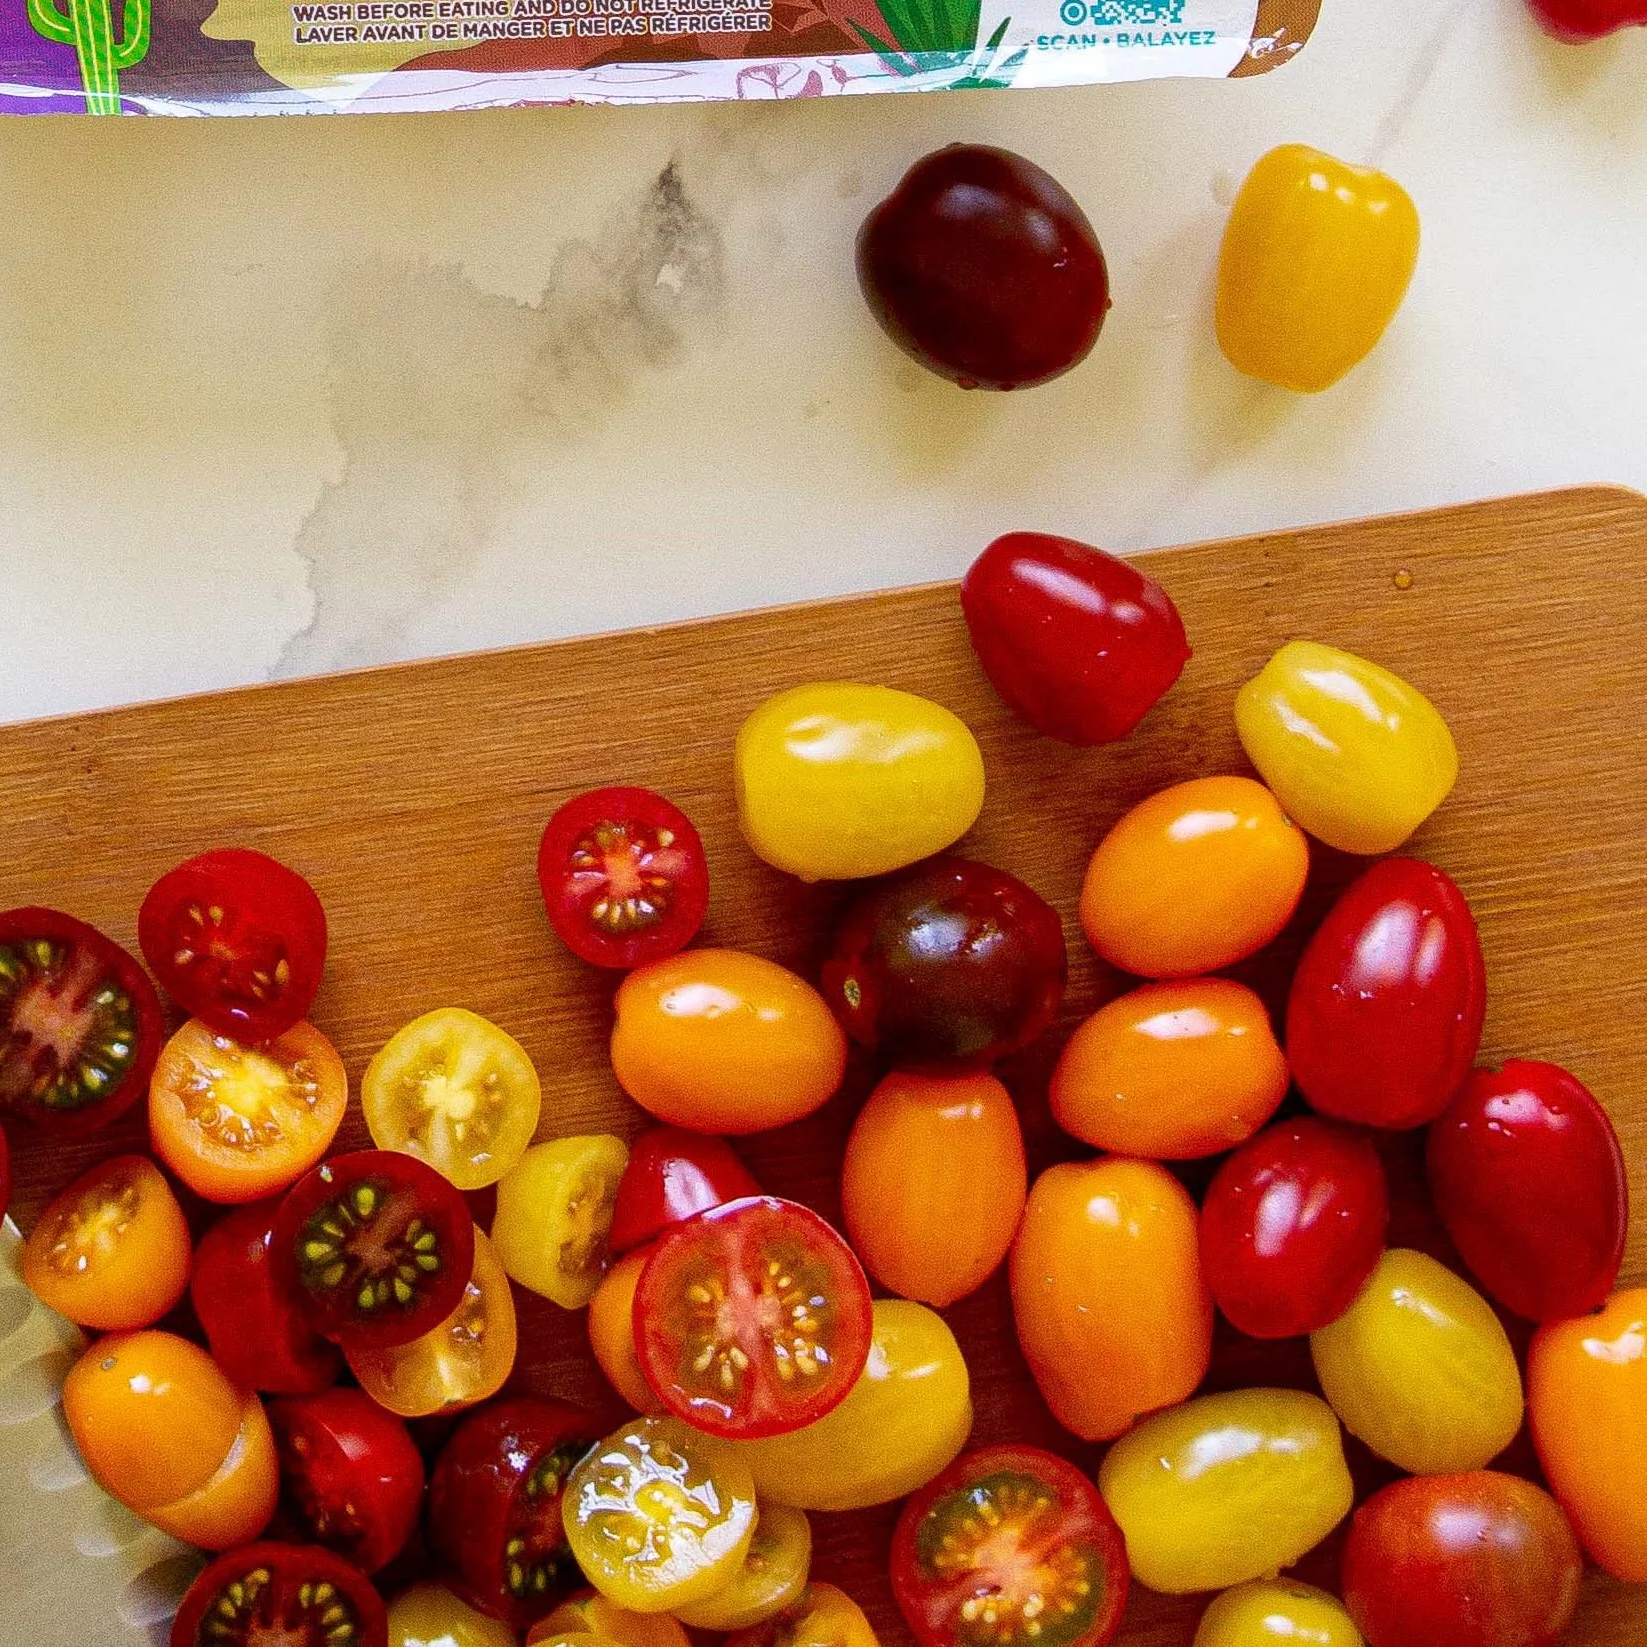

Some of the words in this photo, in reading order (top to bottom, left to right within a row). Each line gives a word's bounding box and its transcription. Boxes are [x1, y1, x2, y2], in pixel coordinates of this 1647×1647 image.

[294, 5, 351, 23] WASH
[358, 2, 433, 21] BEFORE
[439, 0, 508, 19] EATING
[296, 25, 358, 44] LAVER
[363, 23, 426, 41] AVANT
[431, 22, 457, 40] DE
[463, 19, 544, 38] MANGER
[550, 18, 574, 36] ET
[579, 17, 605, 35] NE
[611, 15, 645, 33] PAS
[651, 9, 771, 32] RÉFRIGÉRER
[1037, 35, 1096, 50] SCAN
[1117, 31, 1215, 48] BALAYEZ
